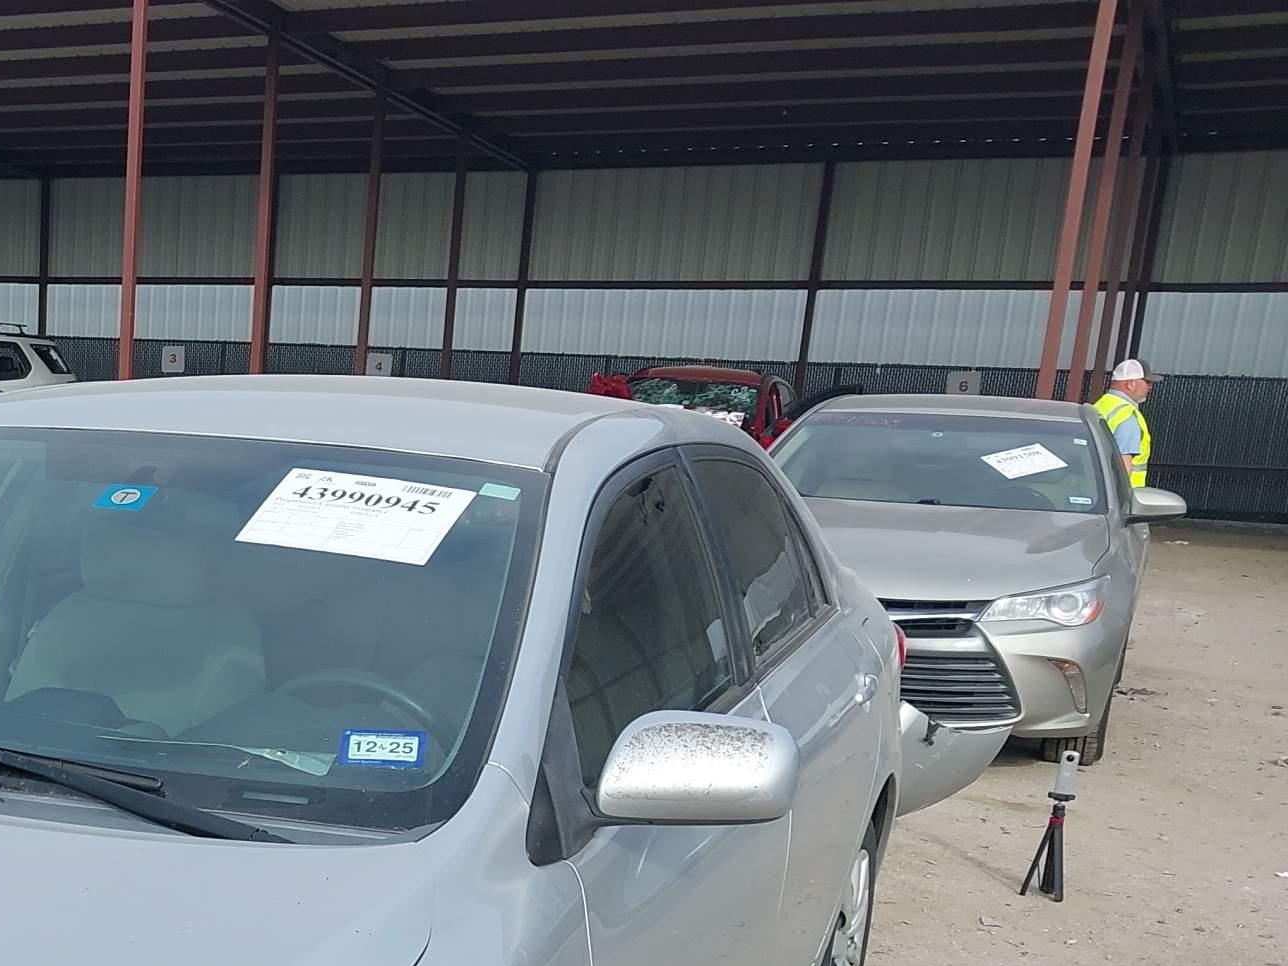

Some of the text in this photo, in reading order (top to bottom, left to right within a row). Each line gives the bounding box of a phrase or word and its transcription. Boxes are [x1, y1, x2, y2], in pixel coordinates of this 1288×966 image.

[169, 353, 178, 364] 3
[374, 362, 383, 372] 4
[959, 380, 969, 393] 6
[291, 485, 441, 515] 43990945
